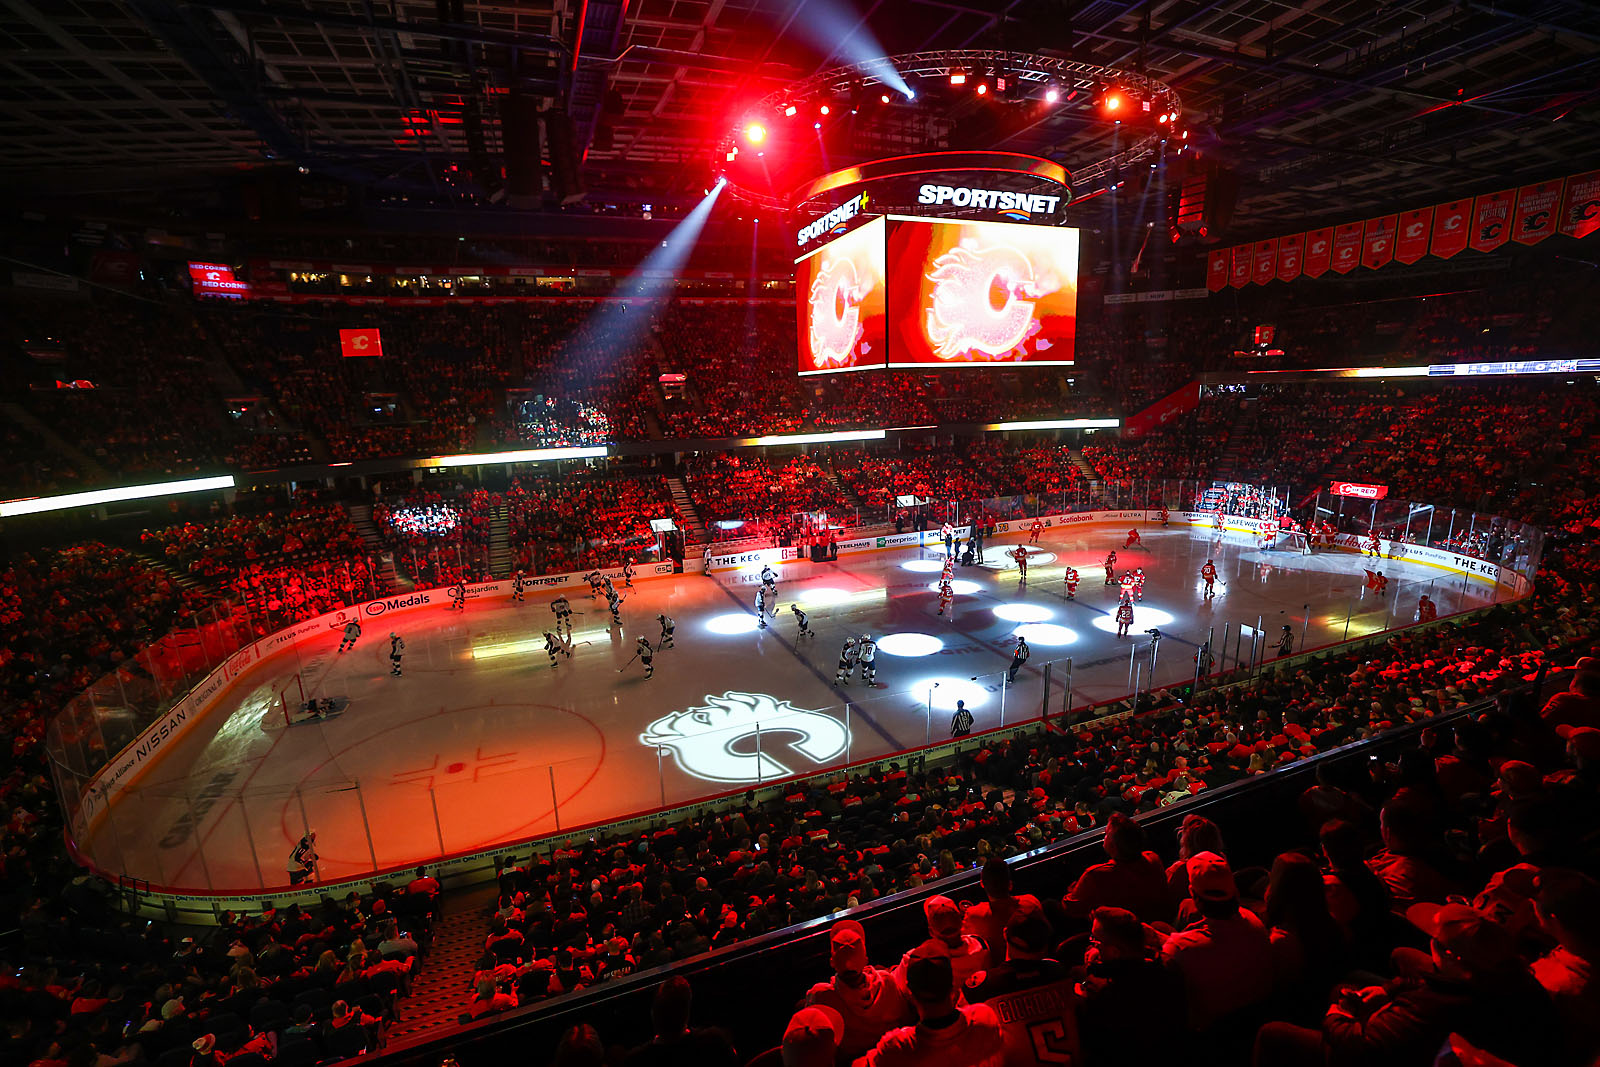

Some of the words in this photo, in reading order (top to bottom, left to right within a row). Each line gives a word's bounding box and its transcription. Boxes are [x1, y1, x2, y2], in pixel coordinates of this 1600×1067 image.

[918, 184, 1060, 214] SPORTSNET
[1059, 514, 1094, 524] Scotiabank
[1227, 517, 1259, 529] SAFEWAY
[715, 557, 737, 566] THE
[740, 554, 761, 563] KEG
[1453, 557, 1476, 571] THE
[1481, 563, 1499, 577] KEG
[520, 576, 570, 588] PORTSNET
[465, 585, 499, 597] esjardins
[387, 594, 430, 612] Medals
[1121, 610, 1132, 619] 22
[276, 632, 297, 644] TELUS
[864, 646, 873, 655] 10
[136, 709, 187, 762] NISSAN
[114, 759, 136, 781] Alliance
